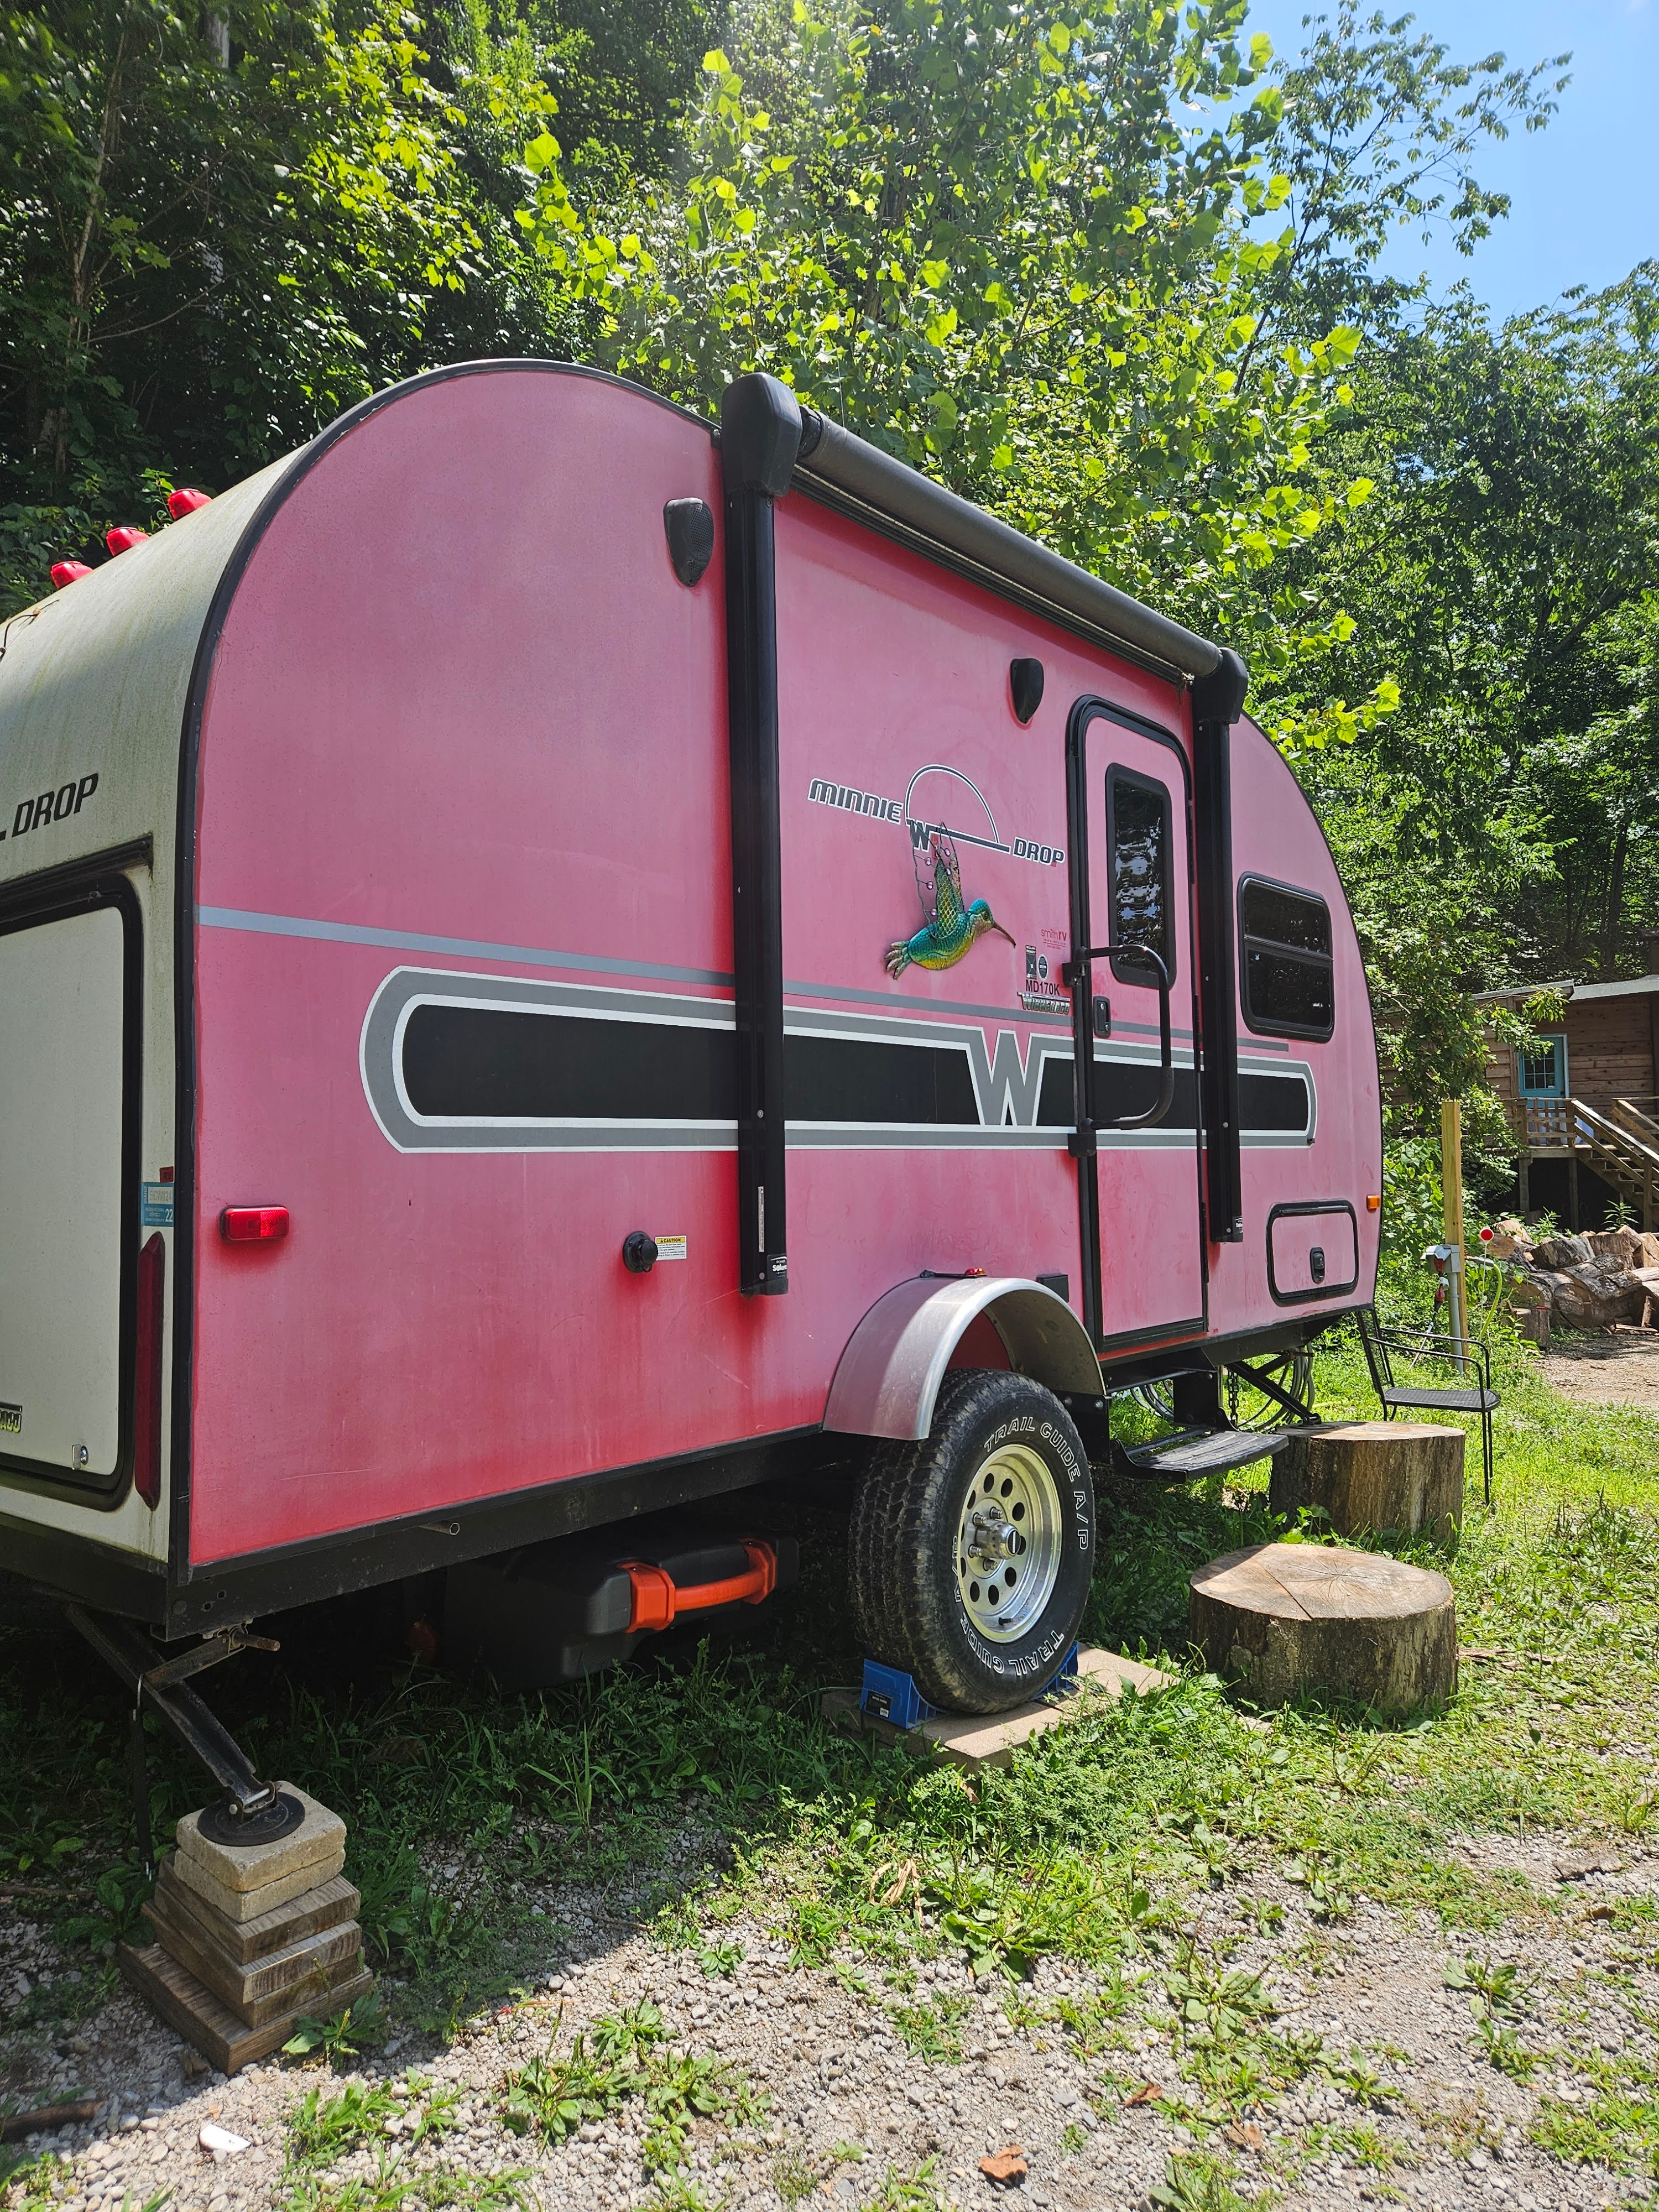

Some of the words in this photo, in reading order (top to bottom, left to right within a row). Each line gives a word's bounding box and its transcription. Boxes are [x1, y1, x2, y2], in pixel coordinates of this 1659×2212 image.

[12, 773, 99, 838] DROP
[807, 778, 903, 825] MINNIE
[1013, 836, 1065, 866] DROP
[1026, 979, 1060, 996] MD170K
[165, 1208, 173, 1222] 22
[984, 1416, 1035, 1453] TRAIL
[1040, 1422, 1081, 1483] GUIDE
[1073, 1491, 1088, 1550] A/P
[960, 1611, 1005, 1674] GUIDE
[1008, 1630, 1065, 1676] TRAIL
